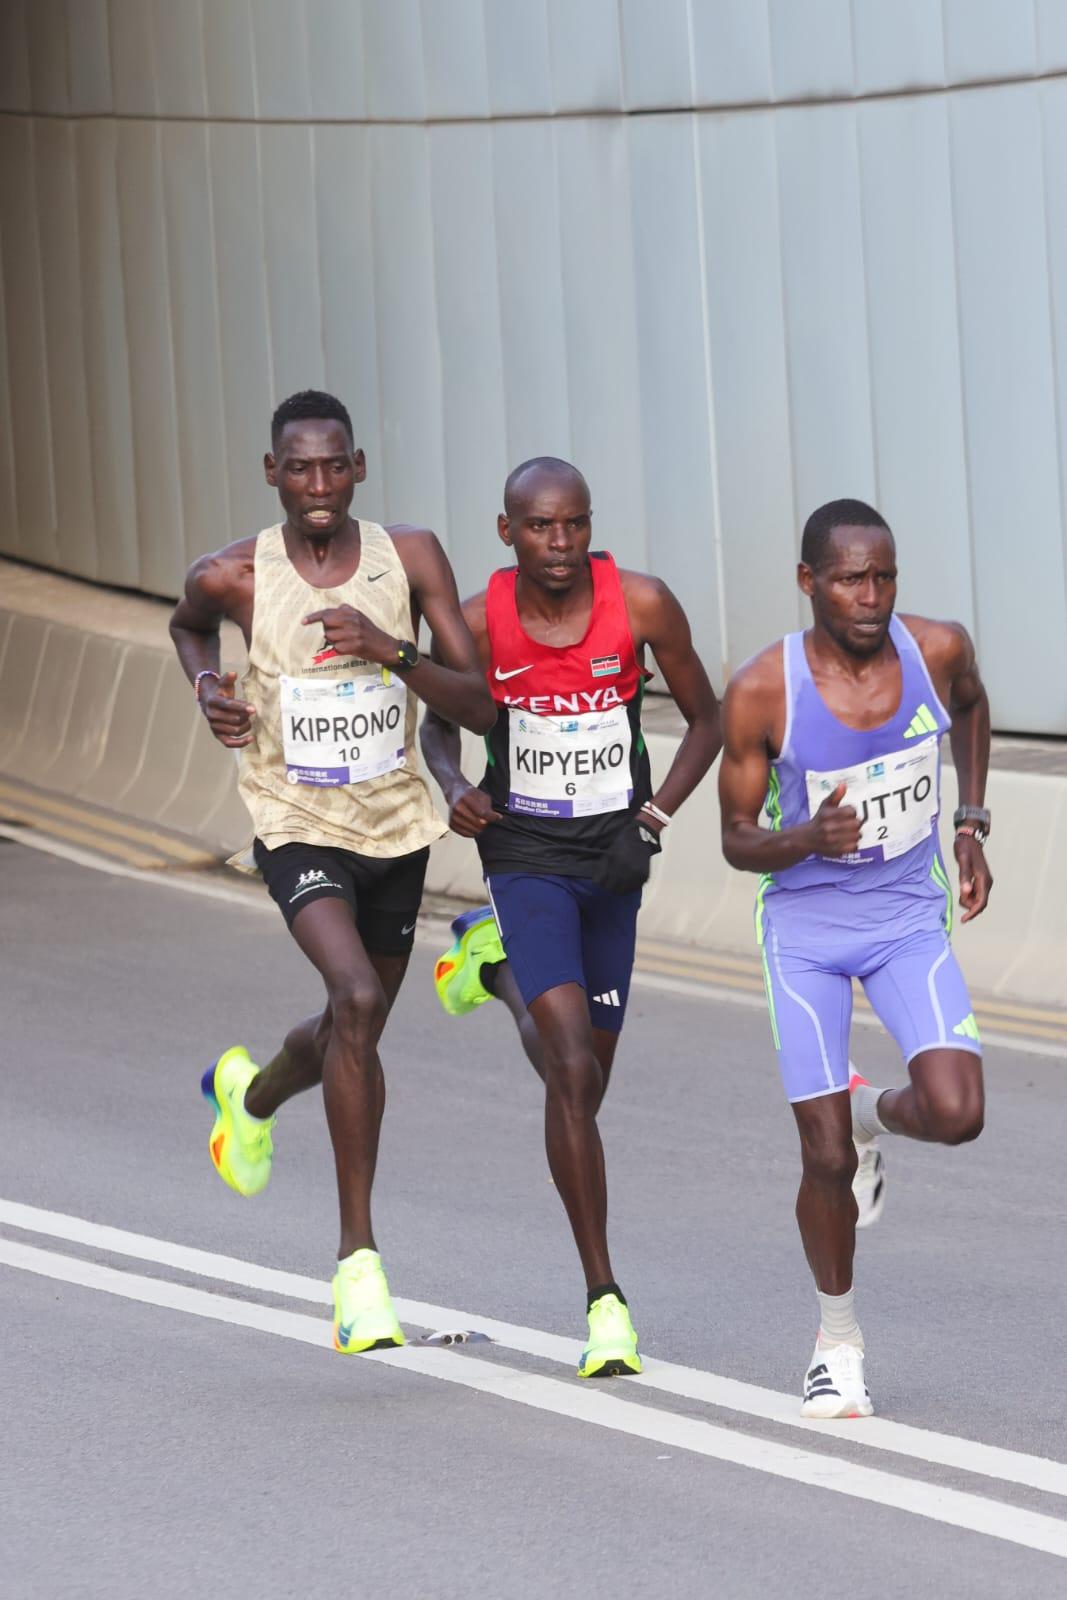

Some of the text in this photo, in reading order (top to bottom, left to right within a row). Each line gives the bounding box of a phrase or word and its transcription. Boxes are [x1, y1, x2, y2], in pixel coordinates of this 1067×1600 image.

[291, 704, 400, 742] KIPRONO
[338, 746, 361, 762] 10
[516, 743, 624, 776] KIPYEKO
[564, 782, 577, 796] 6
[877, 825, 889, 840] 2
